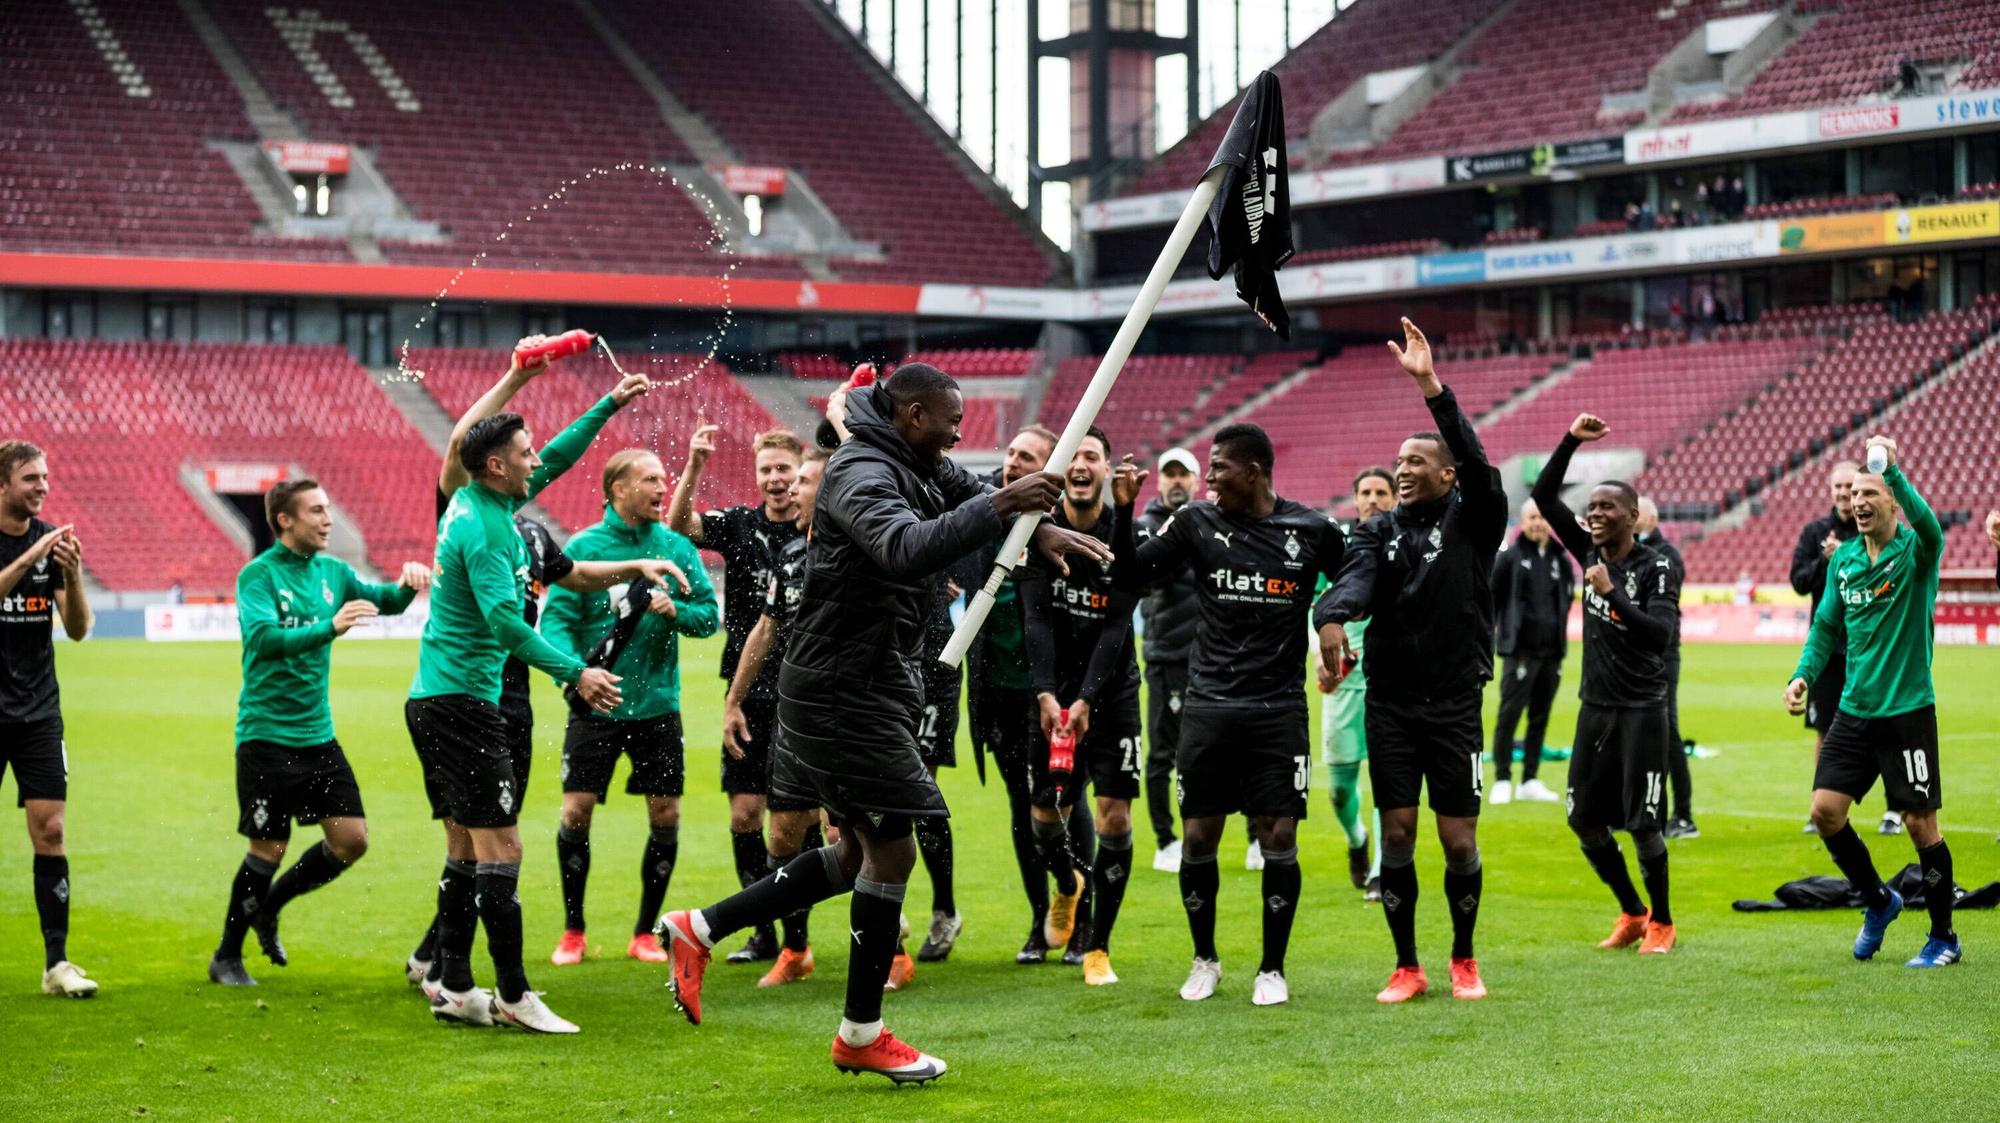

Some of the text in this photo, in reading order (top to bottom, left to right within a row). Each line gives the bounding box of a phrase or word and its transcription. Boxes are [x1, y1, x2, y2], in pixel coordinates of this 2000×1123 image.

[1917, 211, 1989, 232] RENAULT
[1294, 755, 1311, 791] 3
[1902, 749, 1928, 783] 18
[1645, 771, 1661, 805] 16
